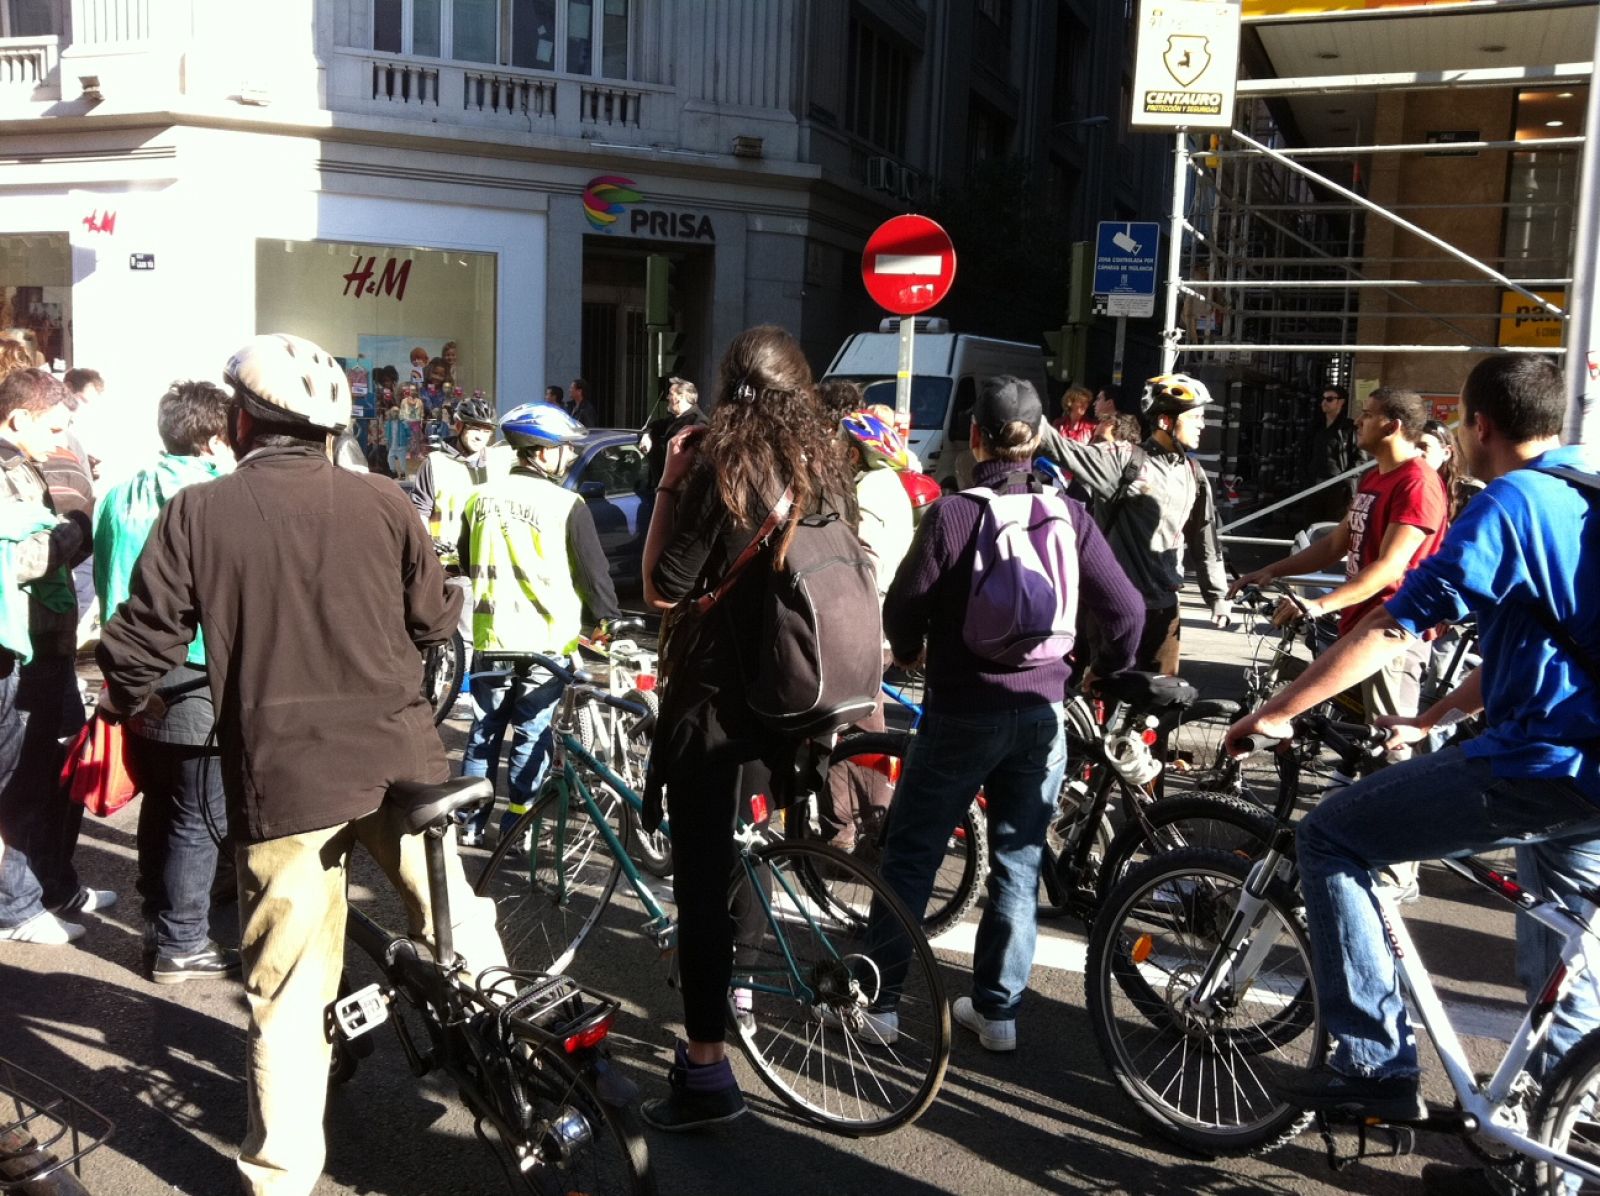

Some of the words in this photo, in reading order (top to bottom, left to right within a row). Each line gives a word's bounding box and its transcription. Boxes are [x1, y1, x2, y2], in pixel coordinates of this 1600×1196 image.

[1146, 92, 1221, 105] CENTAURO
[630, 209, 716, 240] PRISA
[343, 256, 412, 301] H&M
